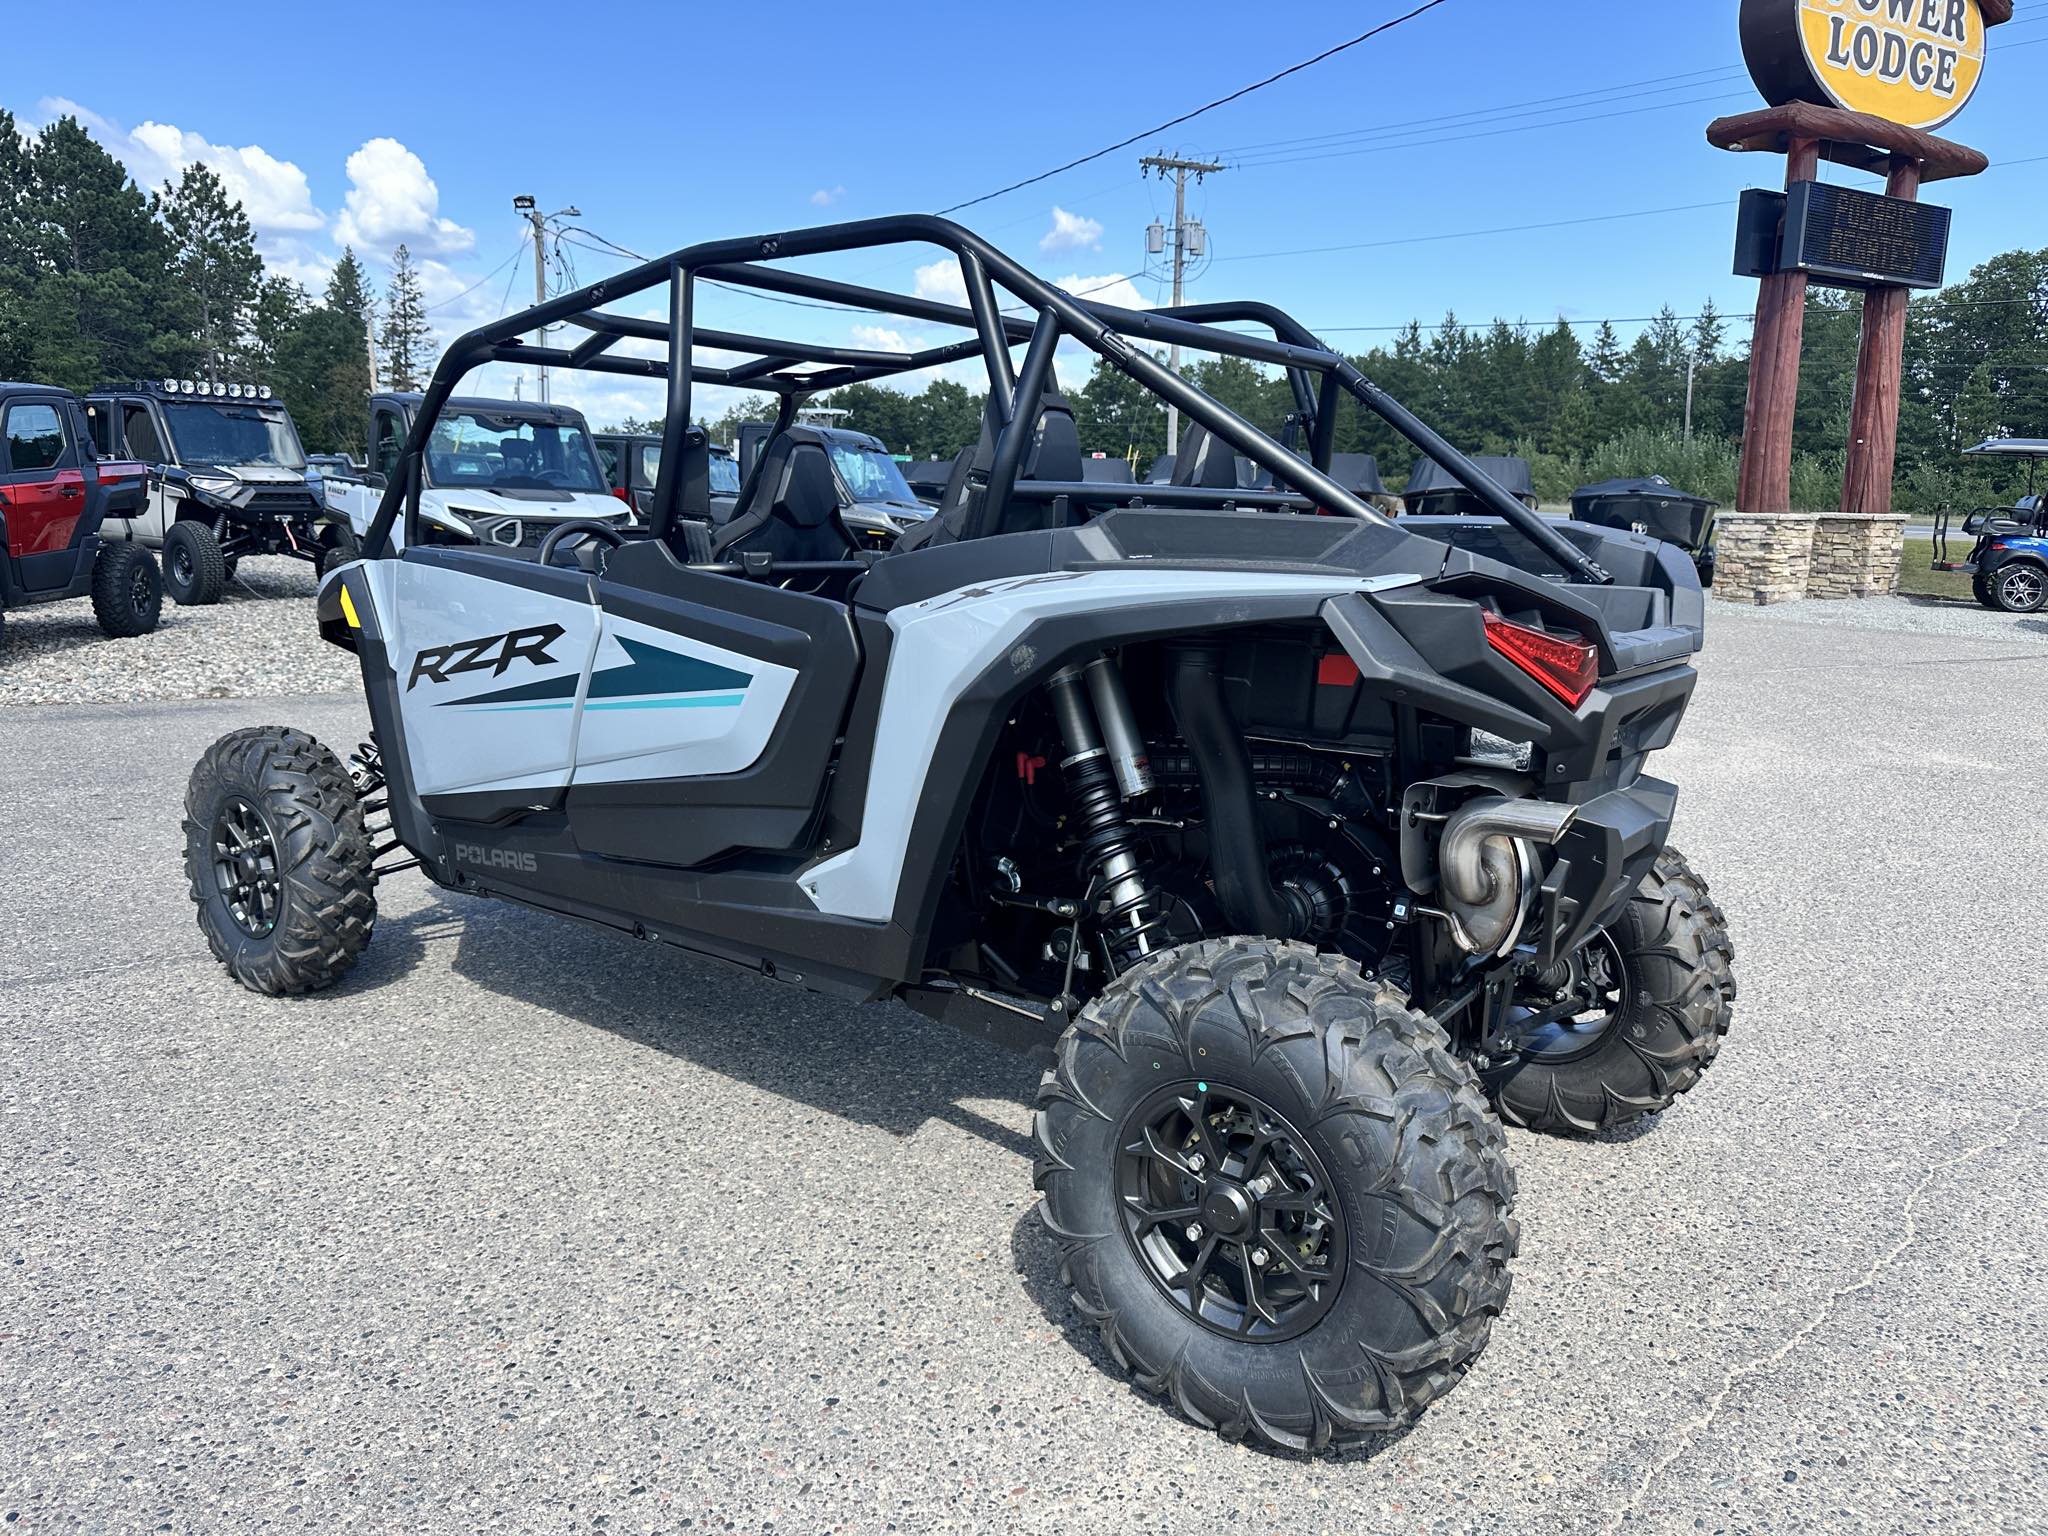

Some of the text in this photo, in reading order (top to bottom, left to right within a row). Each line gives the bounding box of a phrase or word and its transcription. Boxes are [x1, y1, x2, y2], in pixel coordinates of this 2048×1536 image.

[1827, 16, 1957, 94] LODGE
[406, 622, 567, 694] RZR
[455, 843, 537, 872] POLARIS
